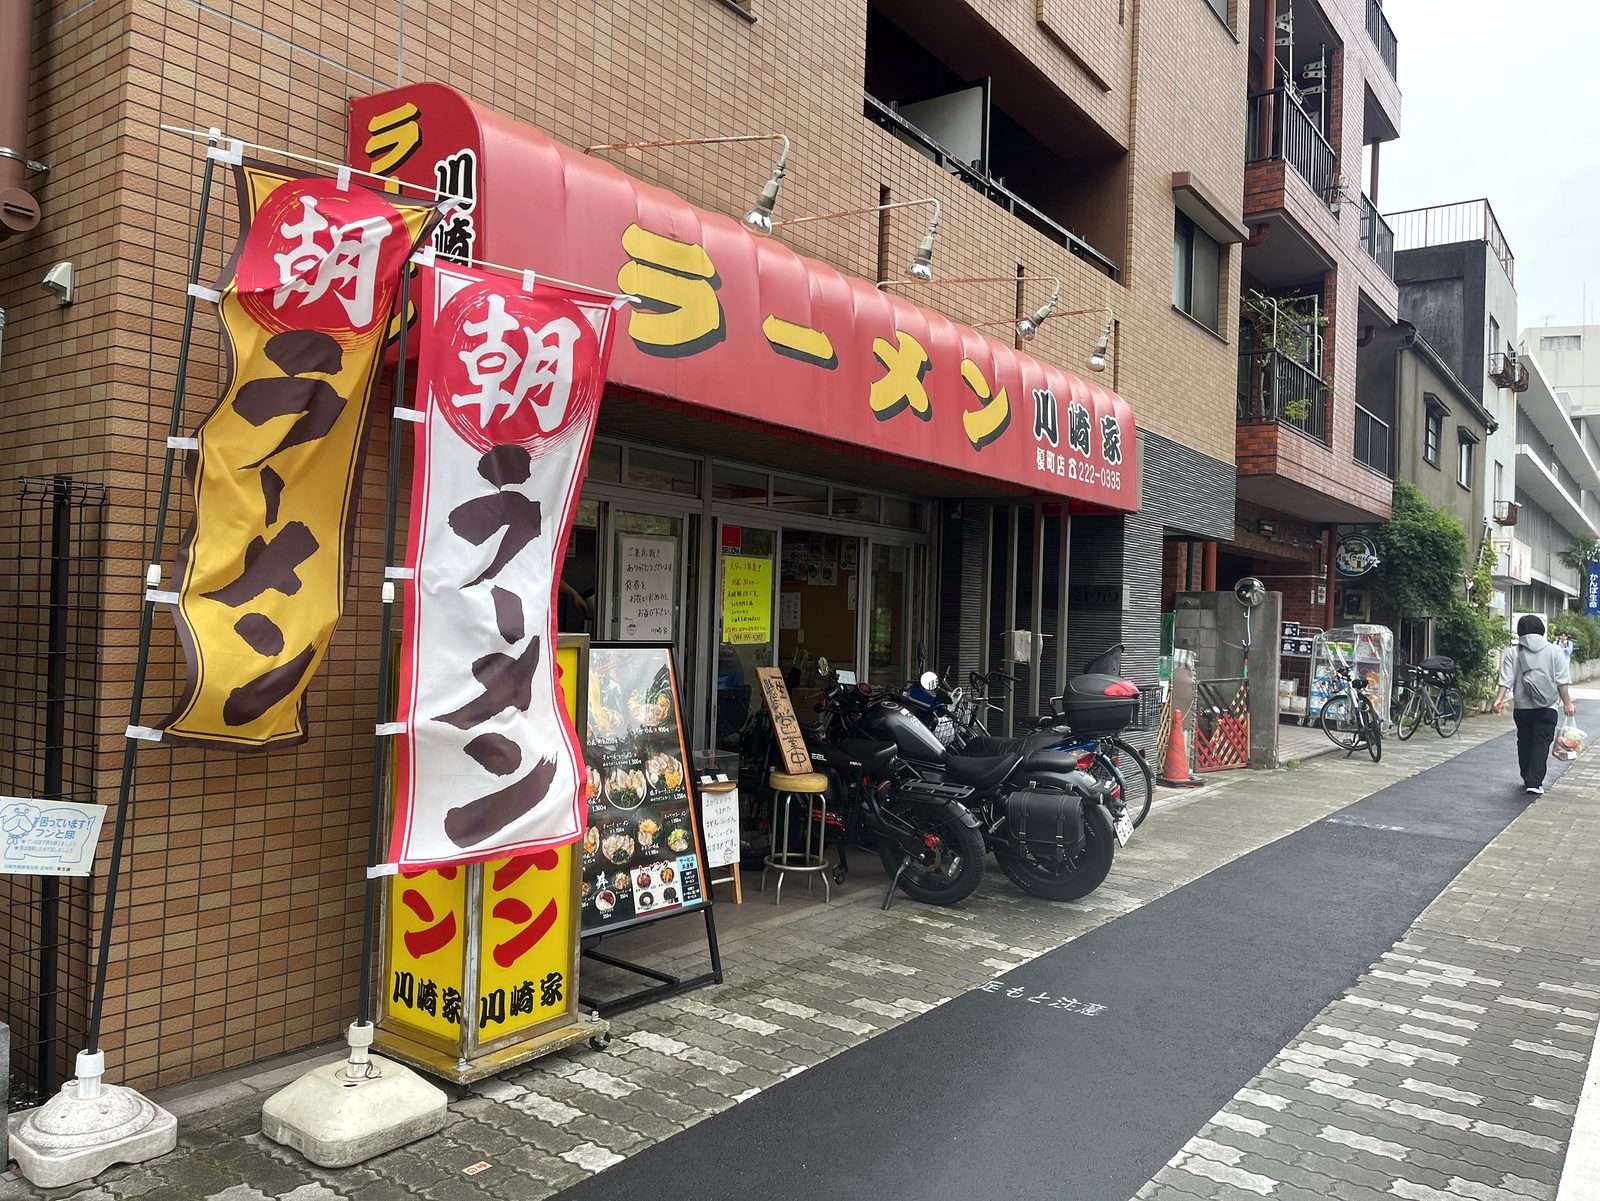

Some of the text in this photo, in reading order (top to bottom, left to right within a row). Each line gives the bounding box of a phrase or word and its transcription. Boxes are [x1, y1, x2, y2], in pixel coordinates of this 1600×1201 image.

[617, 222, 1012, 451] ラーメン
[1032, 389, 1122, 465] 川崎家
[198, 194, 393, 727] 朝 ラーメン
[1079, 462, 1121, 490] 222-0335
[429, 294, 581, 849] 朝 ラーメン
[1588, 574, 1599, 608] かんぽ生命
[35, 828, 76, 840] フンと尿
[39, 816, 91, 831] 困っています!
[596, 870, 609, 891] 丼
[392, 971, 461, 1025] 川崎家
[479, 971, 564, 1028] 川崎家
